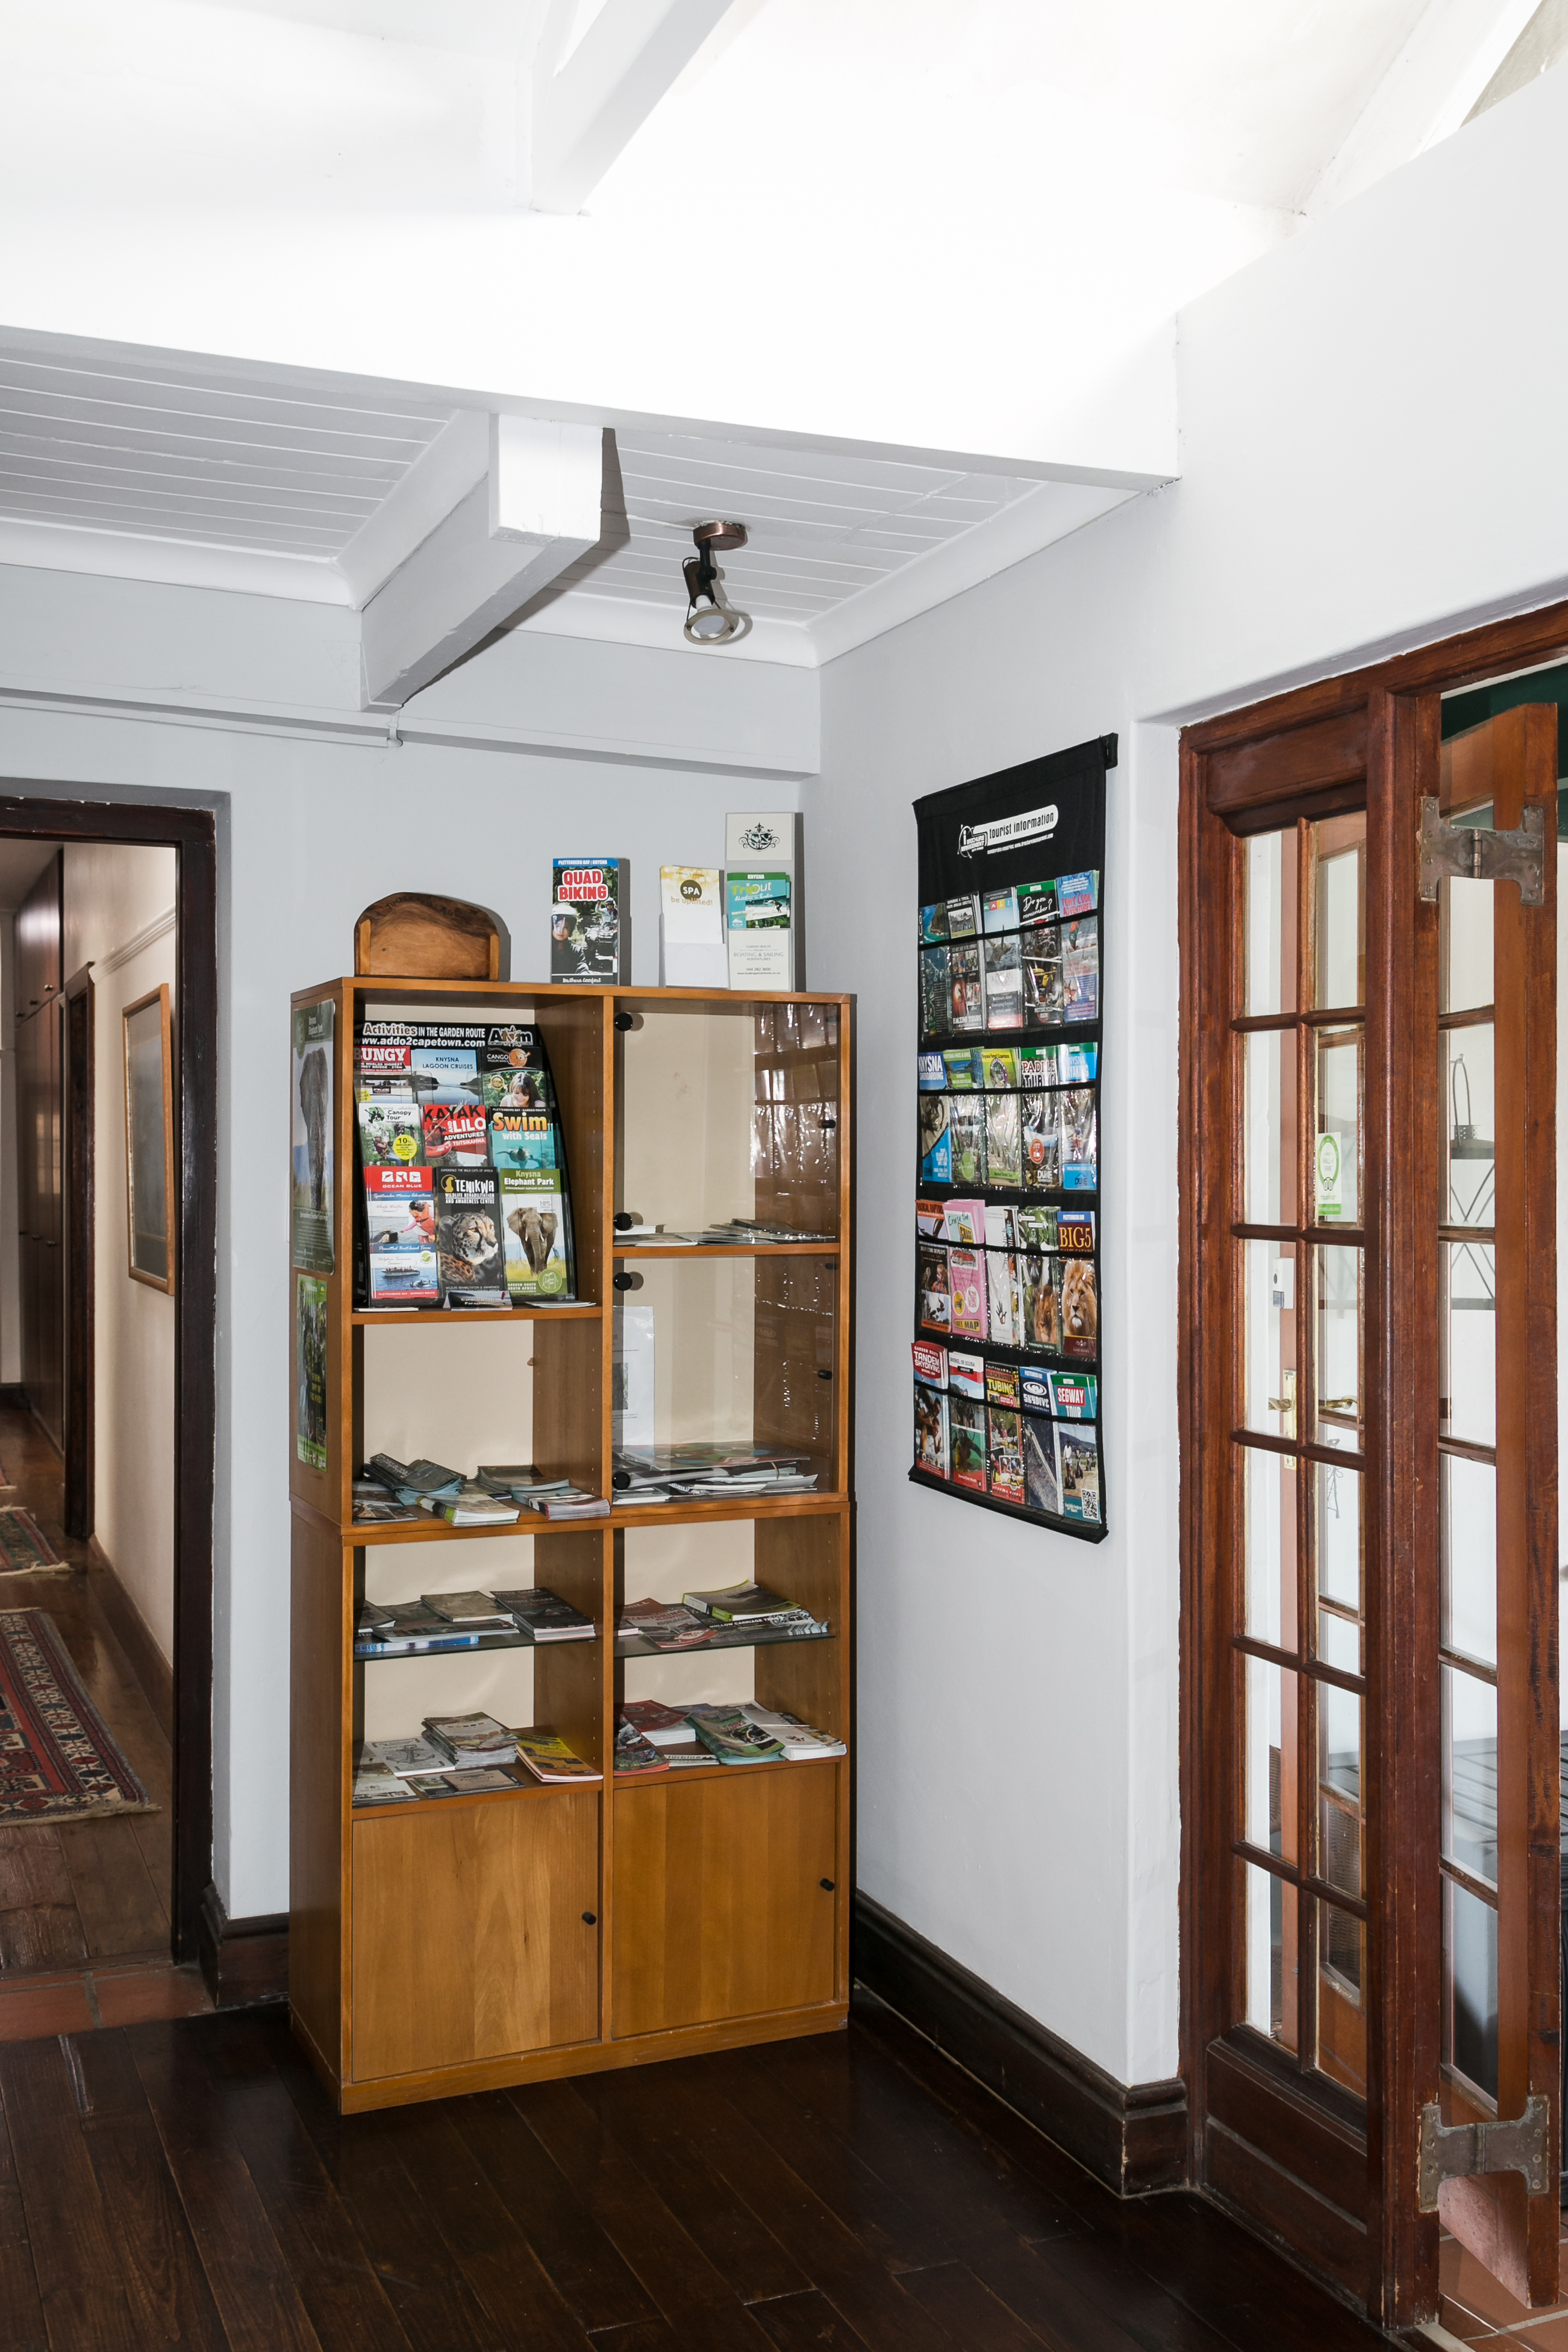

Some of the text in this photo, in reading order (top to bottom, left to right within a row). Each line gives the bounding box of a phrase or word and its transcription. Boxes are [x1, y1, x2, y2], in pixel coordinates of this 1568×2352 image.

[989, 813, 1054, 839] tourist information
[563, 870, 602, 886] QUAD
[558, 885, 607, 900] BIKING
[682, 886, 701, 895] SPA
[682, 897, 713, 906] uplifted!
[1023, 896, 1047, 912] Do you
[1077, 893, 1092, 904] COOK
[1023, 898, 1053, 919] remember?
[1063, 902, 1092, 916] ADVENTURES
[363, 1022, 486, 1038] Activities IN THE GARDEN ROUTE
[354, 1037, 486, 1048] www.addo2capetown.com
[354, 1047, 407, 1062] BUNGY
[918, 1055, 943, 1072] KNYSNA
[424, 1105, 482, 1123] KAYAK
[493, 1112, 548, 1131] Swim
[452, 1117, 487, 1133] LILO
[444, 1131, 485, 1141] ADVENTURES
[502, 1131, 548, 1140] with Seals
[504, 1177, 536, 1186] Elephant
[516, 1170, 542, 1179] Knysna
[1037, 1170, 1053, 1179] DUNE
[455, 1180, 495, 1193] TENIKWA
[948, 1215, 962, 1226] Cruise
[964, 1320, 979, 1330] MAP
[913, 1351, 940, 1367] TANDEM
[914, 1359, 940, 1374] SKYDIVING
[986, 1369, 1014, 1383] BLACKWATER
[987, 1378, 1015, 1395] TUBING
[1023, 1393, 1050, 1409] SKYDIVE
[1057, 1387, 1084, 1404] SEGWAY
[1065, 1405, 1082, 1418] TOUR
